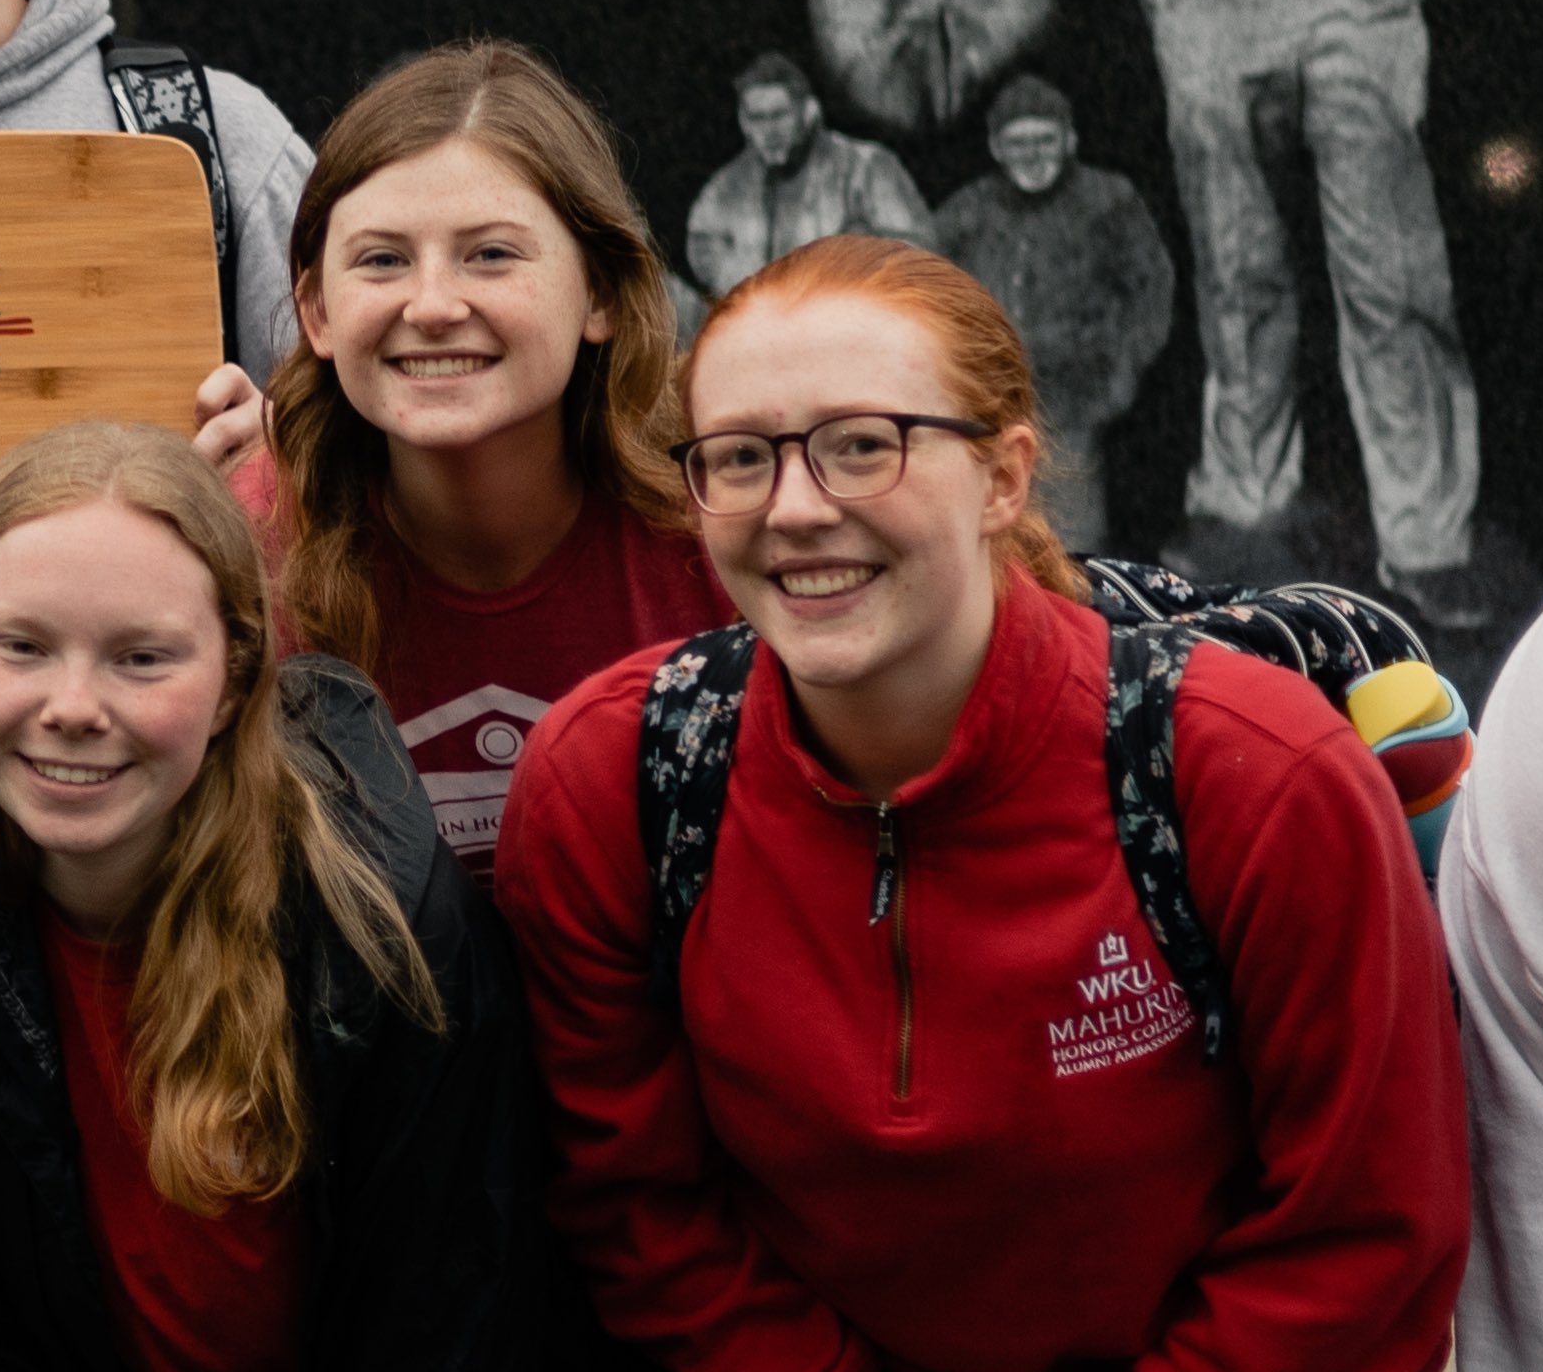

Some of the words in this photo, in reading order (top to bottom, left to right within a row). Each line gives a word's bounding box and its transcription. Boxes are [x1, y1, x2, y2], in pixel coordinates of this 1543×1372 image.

[1077, 959, 1155, 1004] WKU
[1051, 1034, 1129, 1063] HONORS
[1055, 1054, 1113, 1078] ALUMNI
